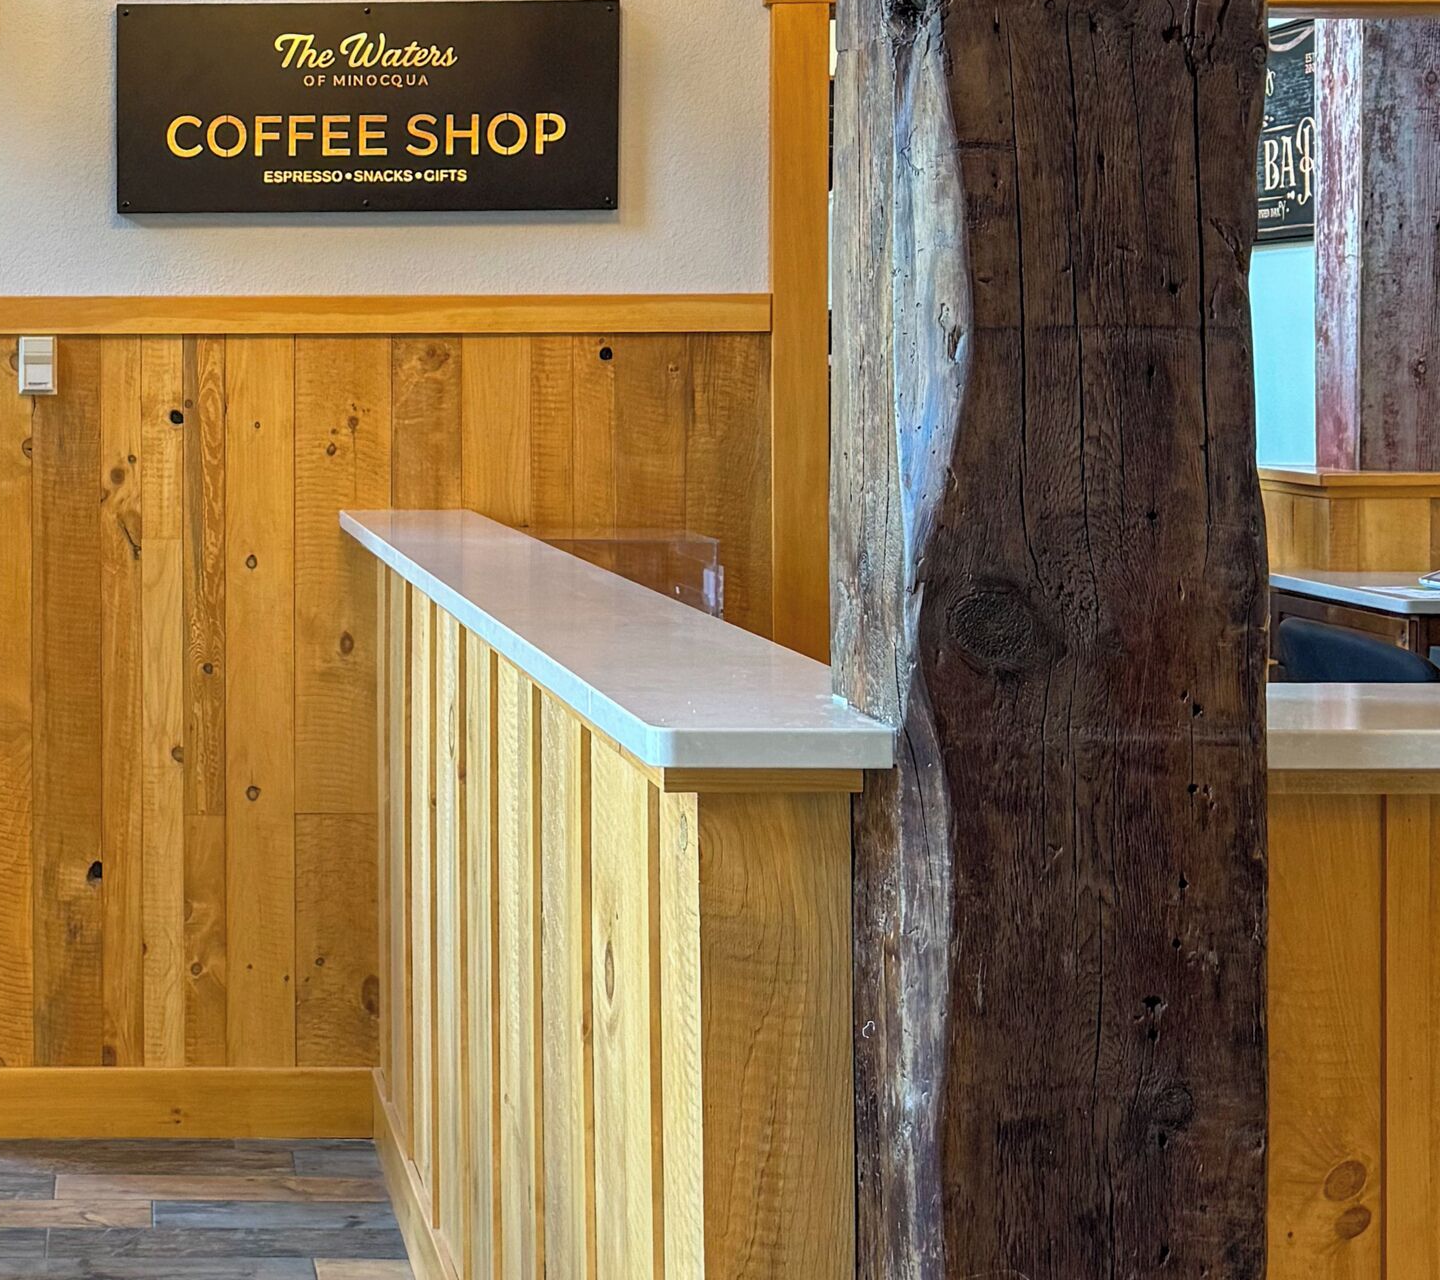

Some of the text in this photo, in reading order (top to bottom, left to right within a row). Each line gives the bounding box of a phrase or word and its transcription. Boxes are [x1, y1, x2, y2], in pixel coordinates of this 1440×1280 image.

[273, 31, 458, 69] The Waters
[303, 73, 429, 89] OF MINOCQUA
[166, 111, 567, 158] COFFEE SHOP
[263, 168, 468, 184] ESPRESSO SNACKS GIFTS
